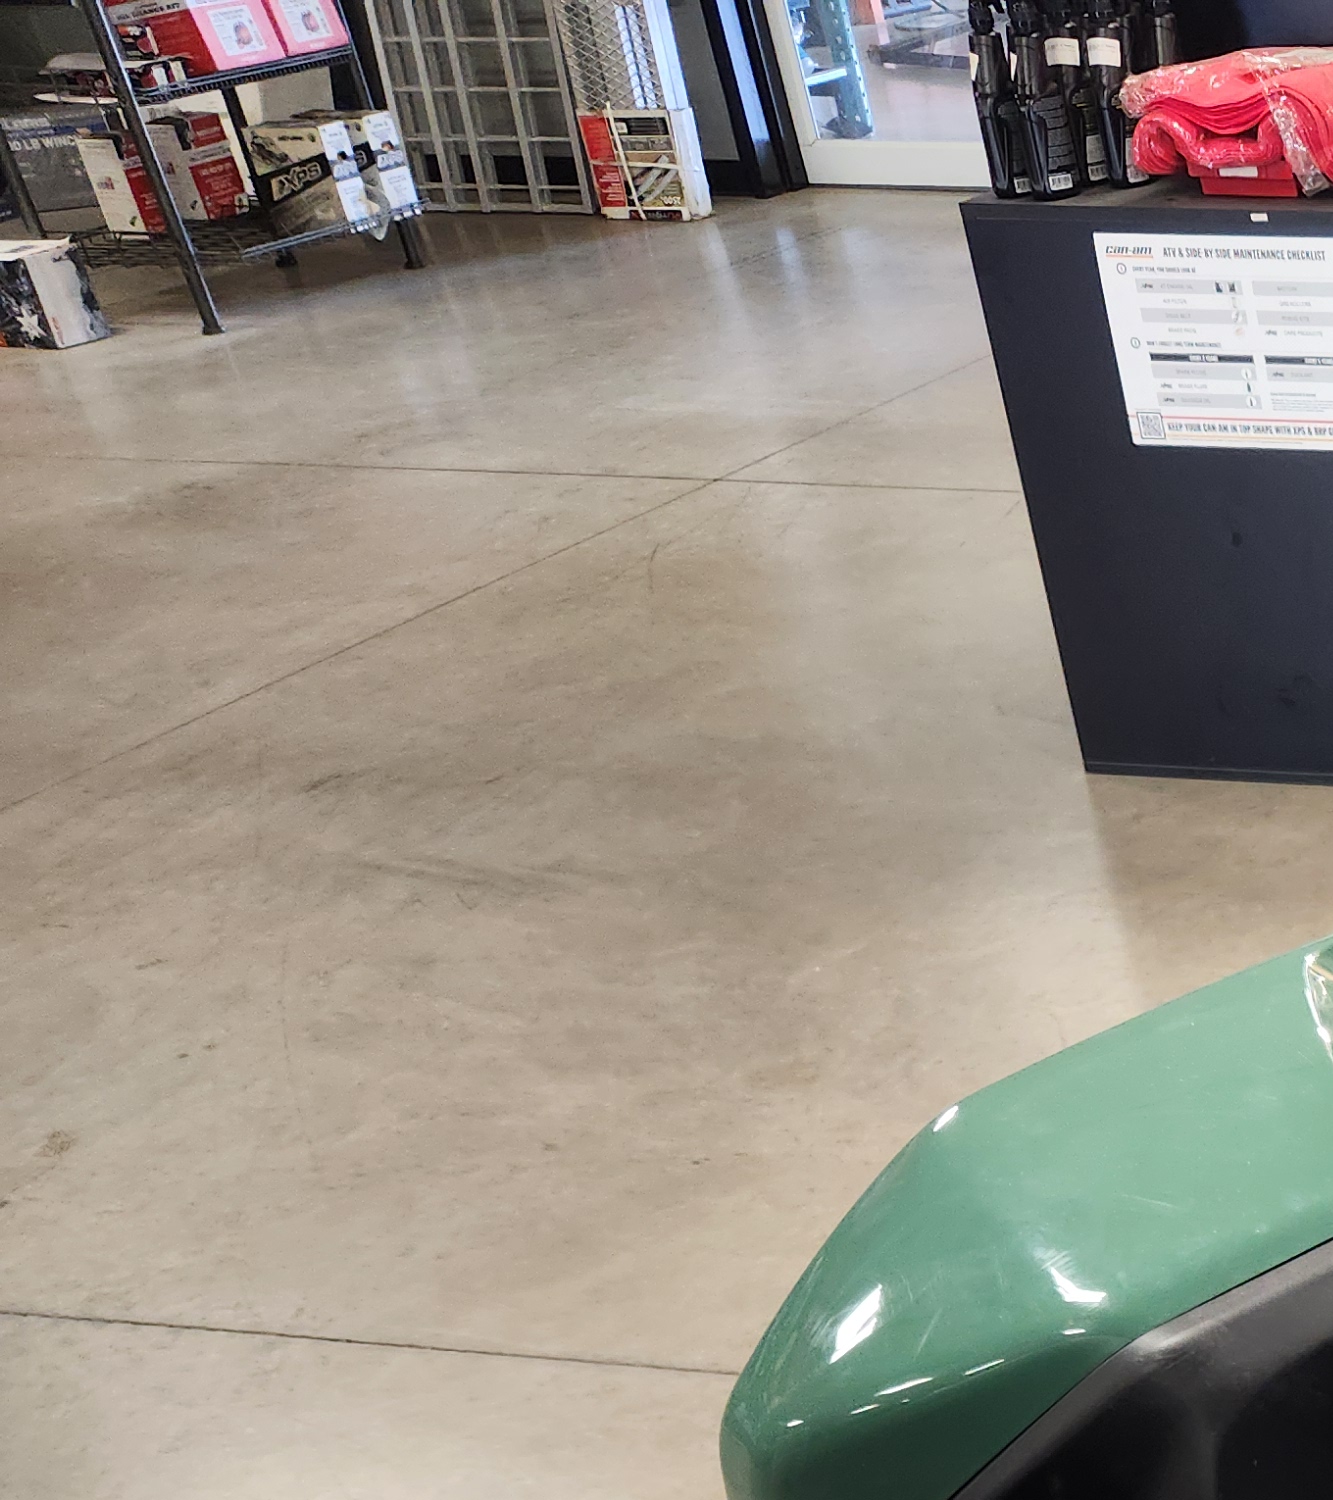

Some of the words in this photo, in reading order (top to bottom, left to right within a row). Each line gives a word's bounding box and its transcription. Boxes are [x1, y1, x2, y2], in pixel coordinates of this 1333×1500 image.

[40, 134, 82, 148] WINC
[270, 161, 322, 201] XPS
[1105, 245, 1152, 256] can-am
[1163, 247, 1176, 258] ATV
[1233, 248, 1285, 260] MAINTENANCE
[1287, 250, 1326, 261] CHECKLIST
[1252, 425, 1273, 435] SHAPE
[1275, 425, 1291, 435] WITH
